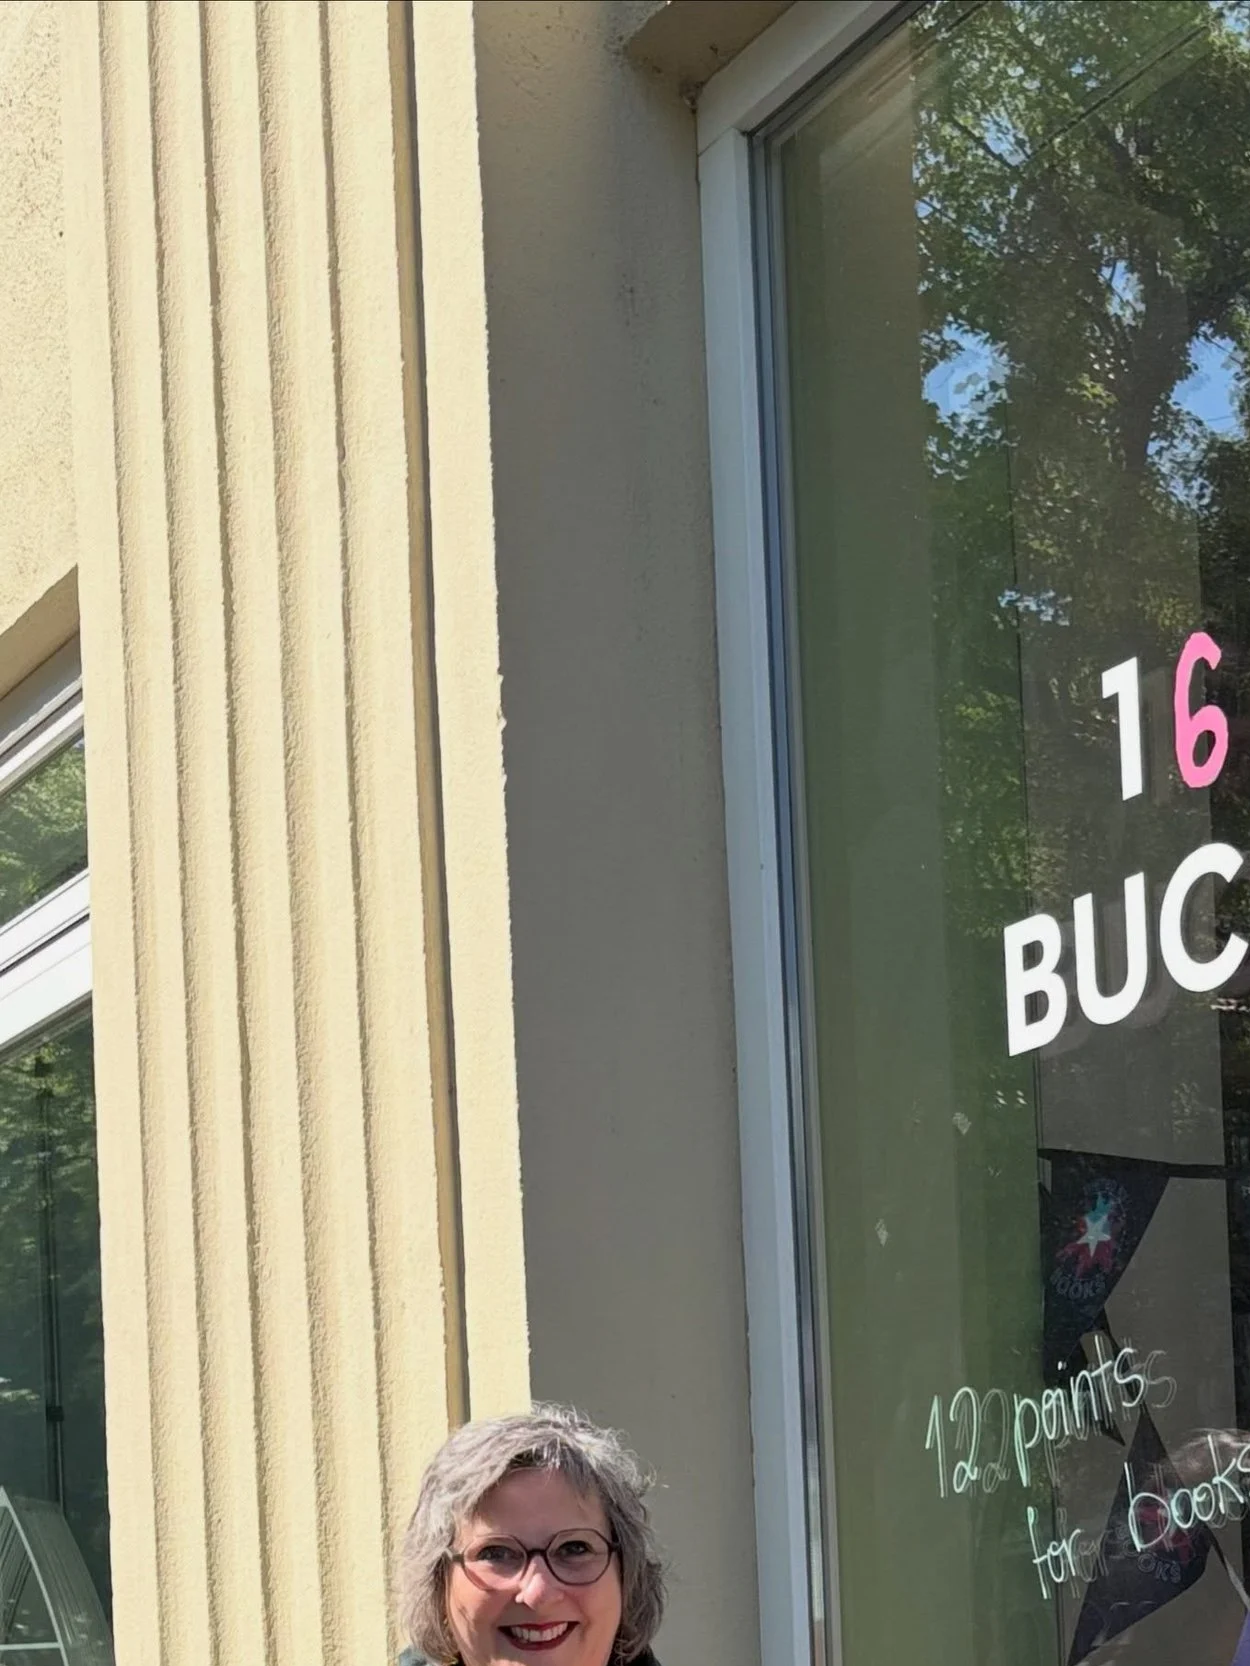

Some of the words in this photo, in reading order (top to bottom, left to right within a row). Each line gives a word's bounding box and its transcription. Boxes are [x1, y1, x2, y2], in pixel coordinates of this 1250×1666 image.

[925, 1387, 980, 1498] 12
[1013, 1334, 1147, 1487] points
[1027, 1506, 1082, 1599] for
